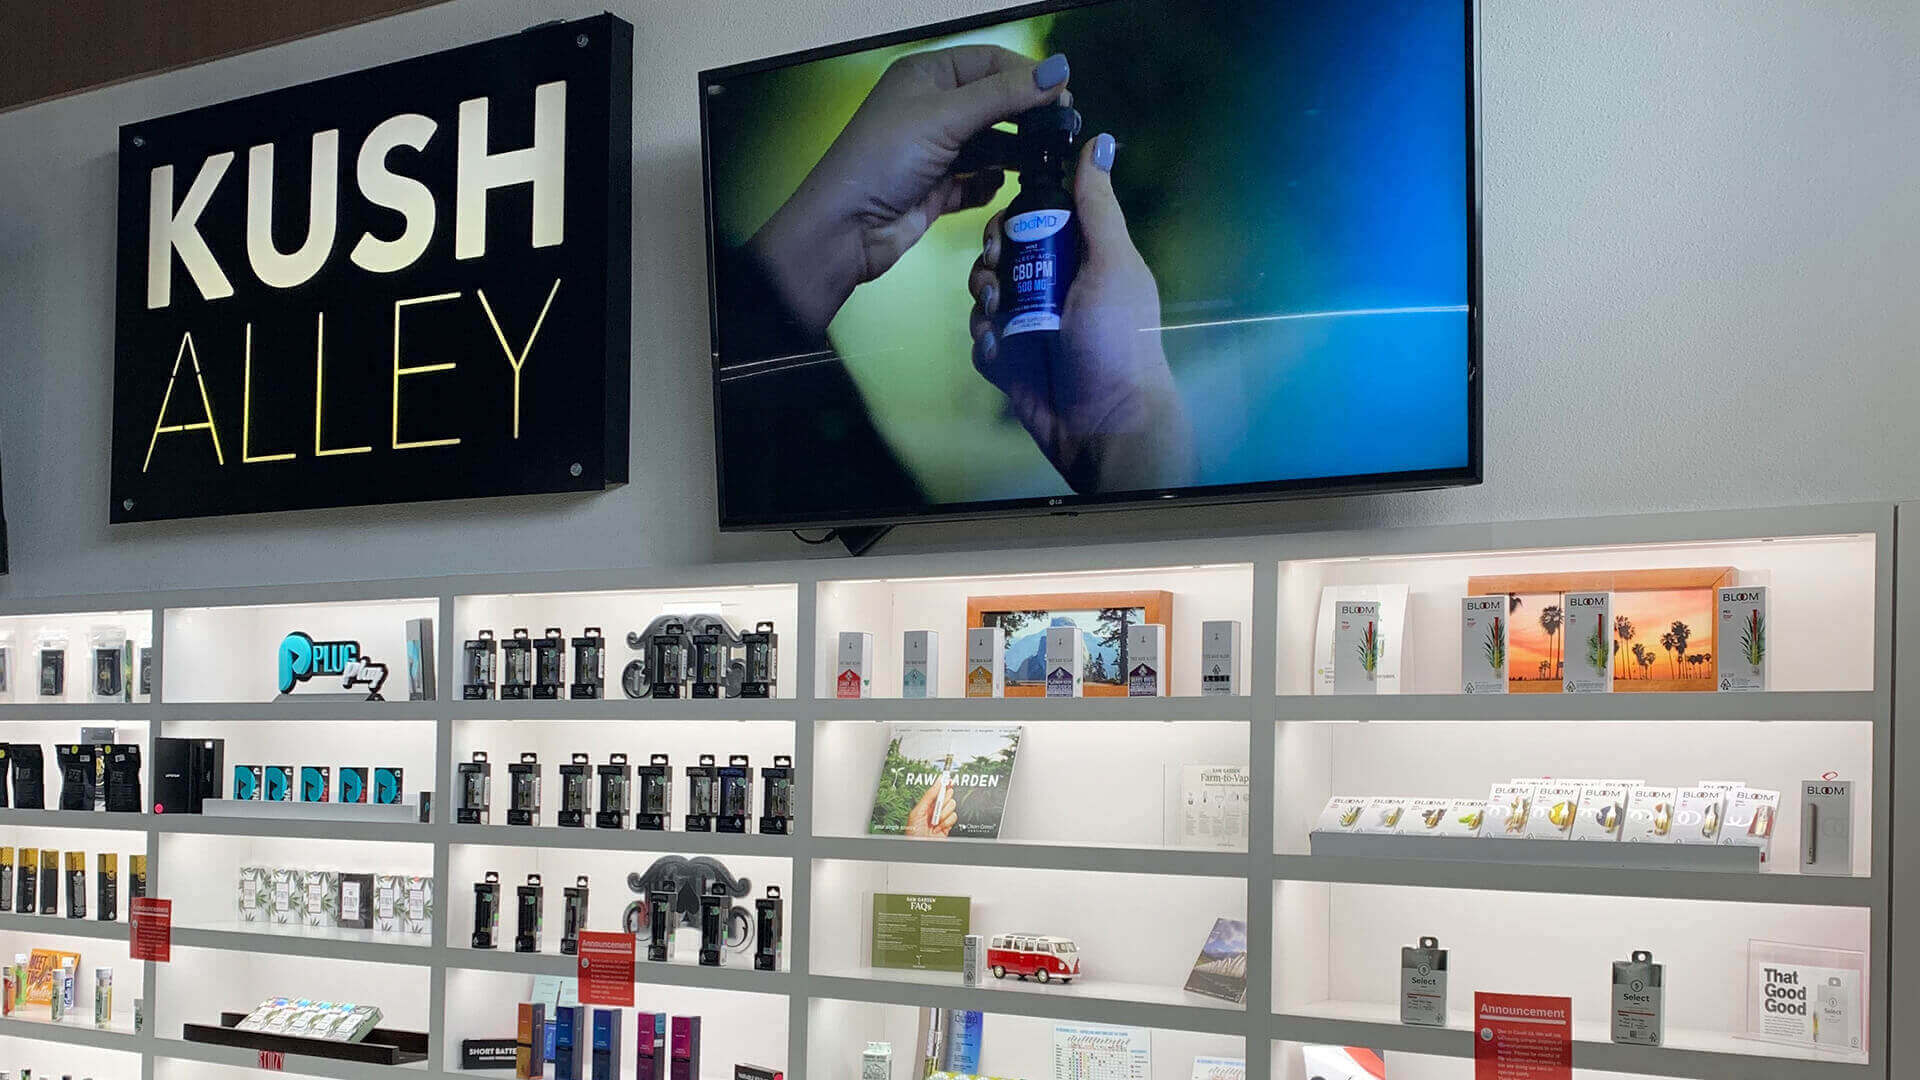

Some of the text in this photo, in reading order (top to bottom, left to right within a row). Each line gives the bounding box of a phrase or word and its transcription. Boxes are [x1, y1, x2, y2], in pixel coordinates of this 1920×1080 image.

[147, 80, 567, 310] KUSH
[1012, 259, 1053, 281] CBD PM
[143, 277, 562, 473] ALLEY
[1570, 597, 1605, 606] BLOOM
[1722, 592, 1759, 602] BLOOM
[1341, 606, 1376, 615] BLOOM
[1467, 601, 1501, 611] BLOOM
[312, 643, 358, 674] PLUG
[905, 772, 938, 786] RAW
[1635, 790, 1672, 799] BLOOM
[1682, 791, 1720, 799] BLOOM
[1736, 791, 1776, 801] BLOOM
[1806, 786, 1846, 796] BLOOM
[910, 901, 932, 912] FAQs
[1411, 976, 1437, 986] Select
[1763, 967, 1799, 985] That
[1764, 983, 1807, 1001] Good
[1623, 993, 1651, 1003] Select
[1480, 1003, 1566, 1018] Announcement
[1764, 998, 1807, 1016] Good
[469, 1047, 494, 1056] SHORT
